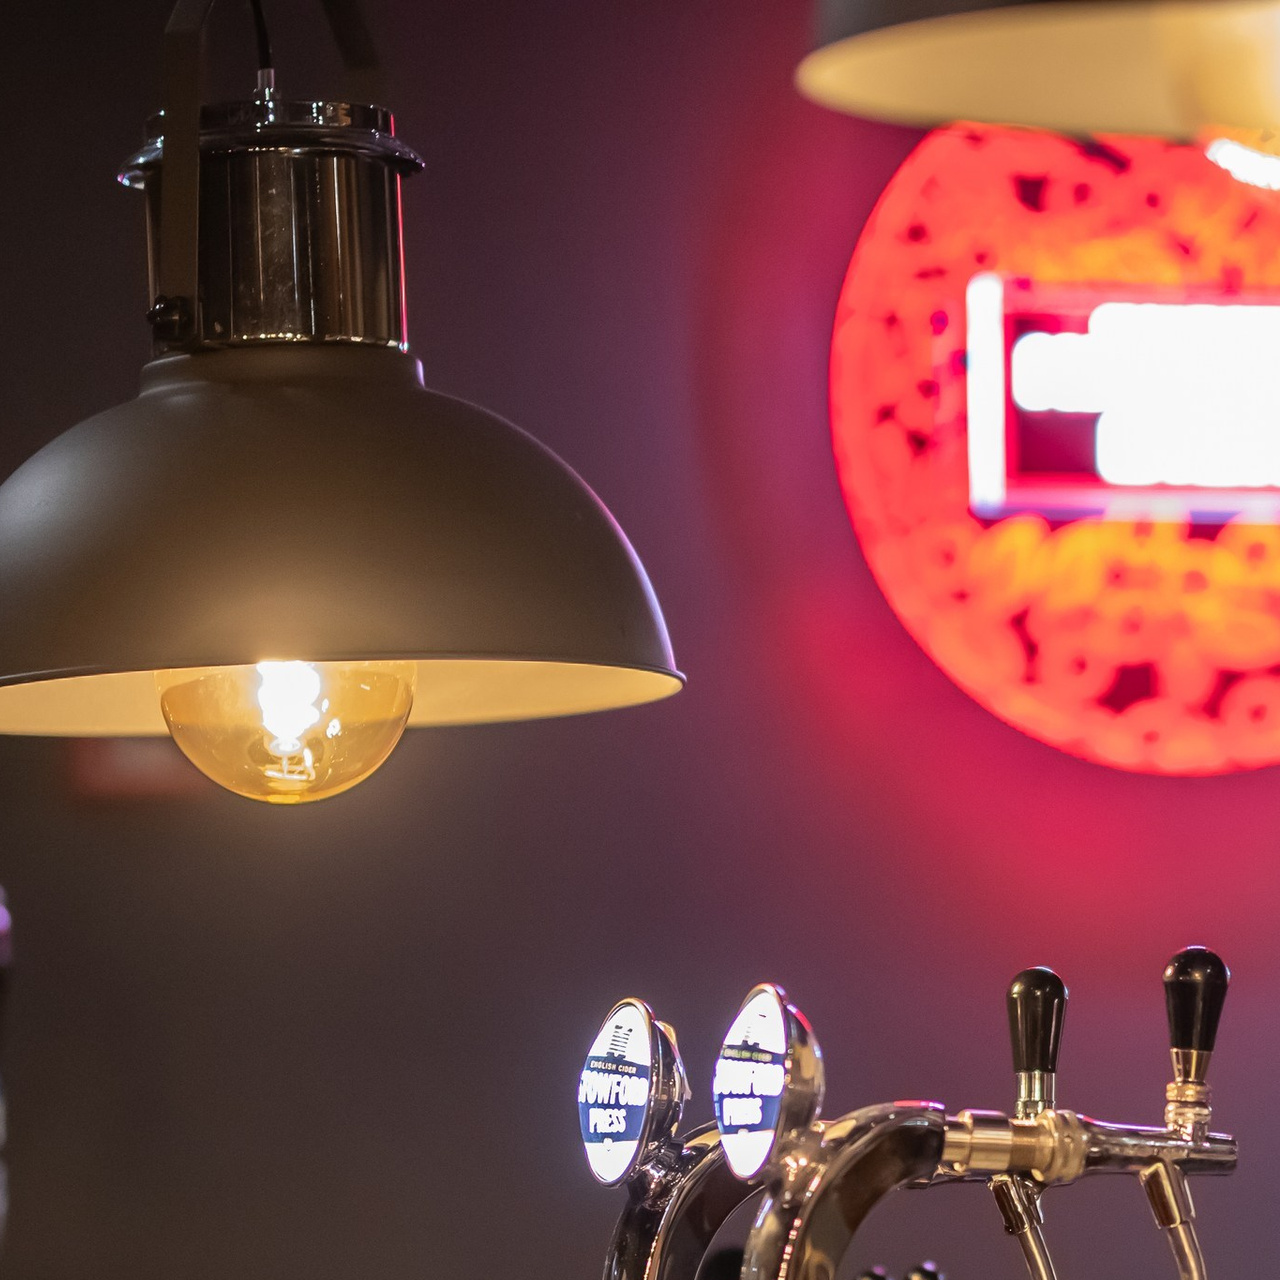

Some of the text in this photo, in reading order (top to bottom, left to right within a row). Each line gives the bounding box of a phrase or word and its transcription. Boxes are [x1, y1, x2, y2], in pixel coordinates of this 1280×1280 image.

[590, 1060, 637, 1074] ENGLISH CIDER
[589, 1107, 627, 1133] PRESS
